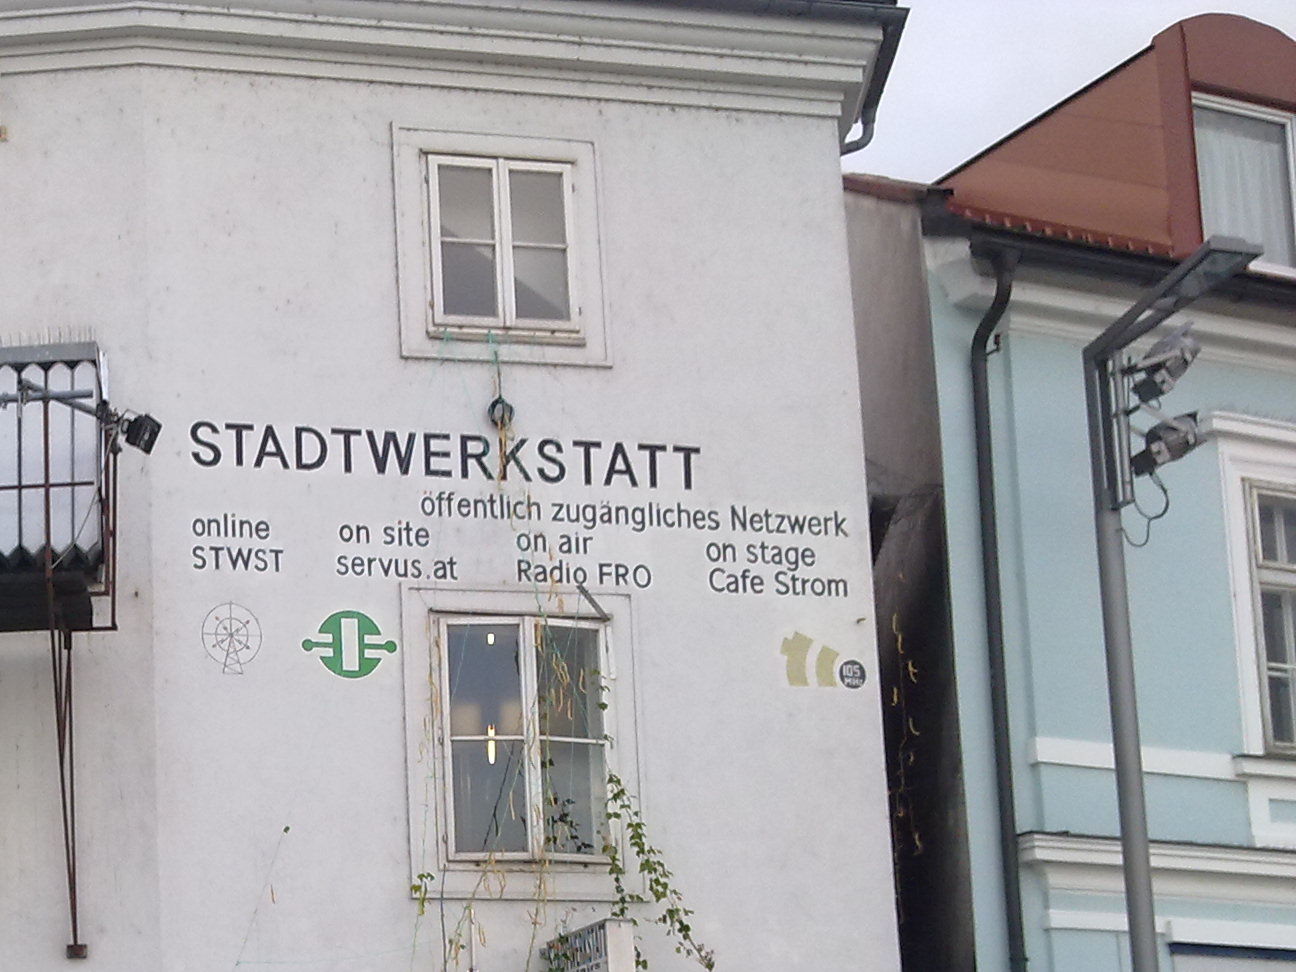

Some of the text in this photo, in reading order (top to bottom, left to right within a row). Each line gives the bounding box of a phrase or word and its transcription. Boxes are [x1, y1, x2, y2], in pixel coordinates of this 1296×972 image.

[189, 420, 701, 490] STADTWERKSTATT
[192, 513, 271, 540] online
[421, 491, 849, 538] öffentlich zugängliches Netzwerk
[339, 521, 431, 547] on site
[516, 532, 593, 555] on air
[192, 546, 284, 573] STWST
[336, 554, 458, 580] servus.at
[706, 542, 816, 571] on stage
[517, 560, 651, 588] Radio FRO
[709, 567, 848, 597] Cafe Strom
